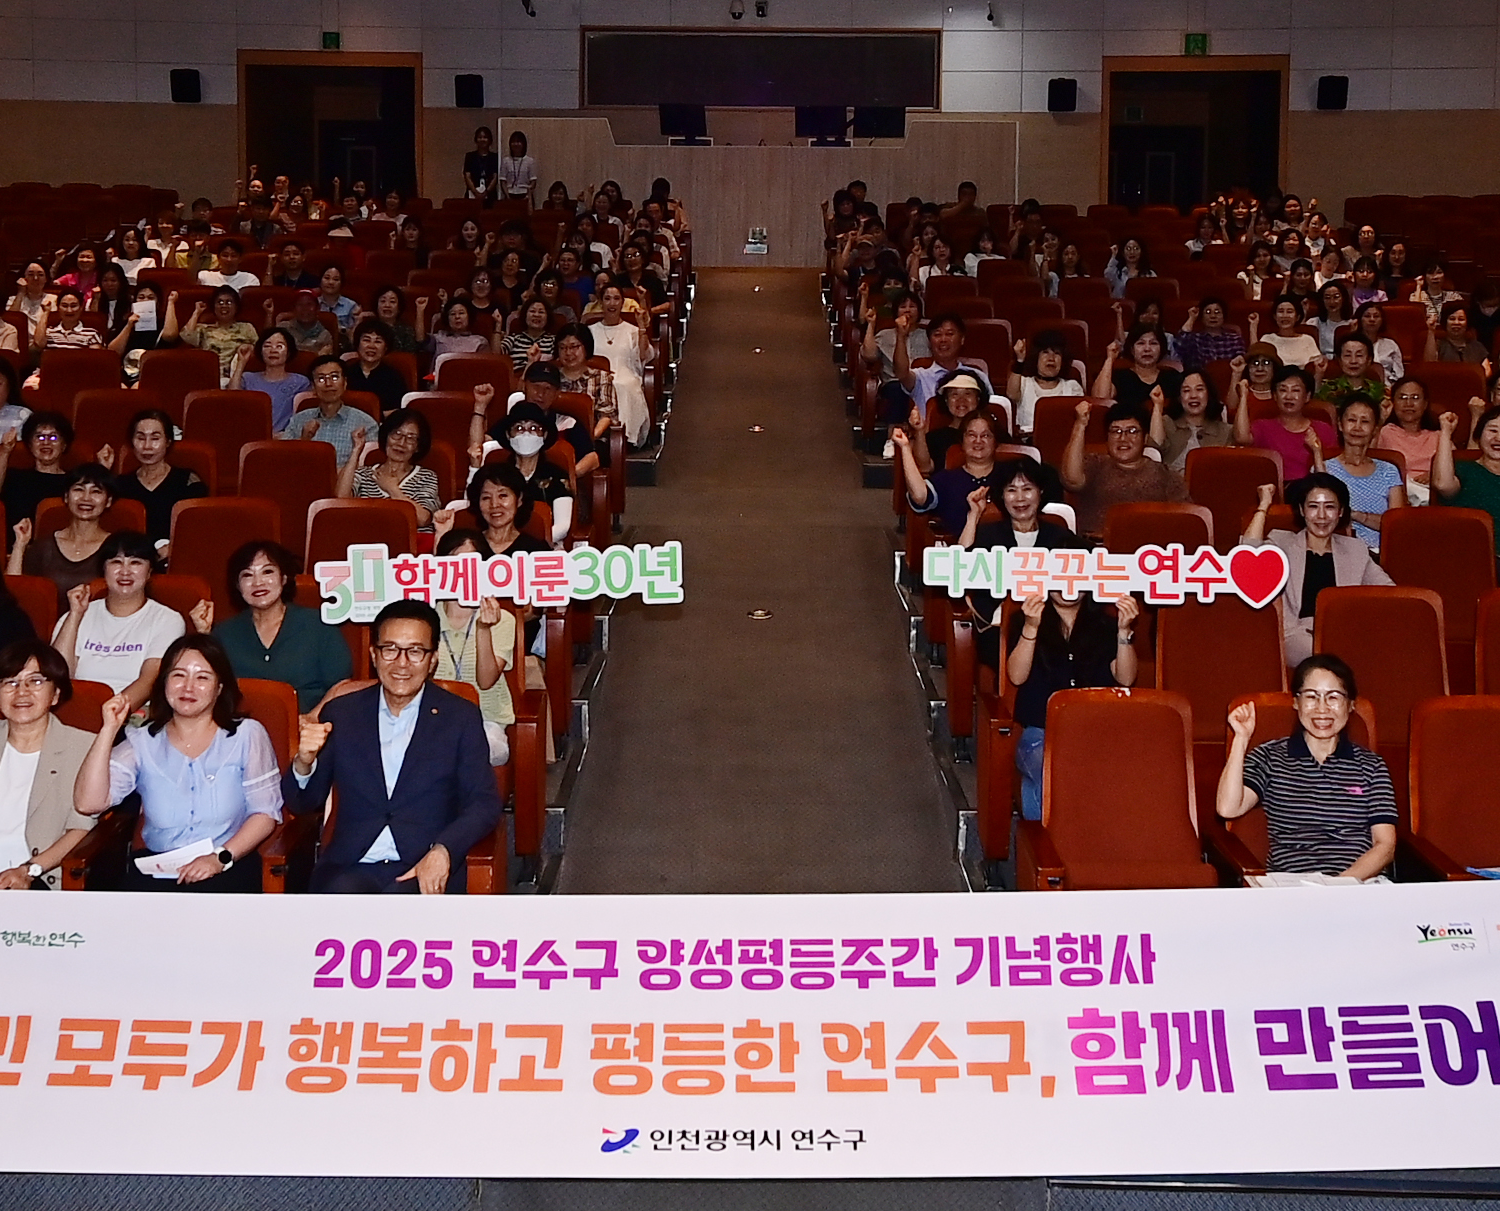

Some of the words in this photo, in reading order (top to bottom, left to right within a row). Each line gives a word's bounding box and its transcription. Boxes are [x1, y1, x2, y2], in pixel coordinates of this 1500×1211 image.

[392, 559, 478, 601] 함께
[927, 550, 1003, 593] 다시
[1011, 551, 1130, 598] 꿈꾸는
[1138, 548, 1228, 600] 연수
[313, 938, 453, 990] 2025
[471, 938, 619, 990] 연수구
[636, 937, 939, 991] 양성평등주간
[954, 932, 1156, 988] 기념행사
[46, 1018, 265, 1091] 모두가
[285, 1017, 564, 1094] 행복하고
[590, 1018, 800, 1096] 평등한
[821, 1020, 1056, 1098] 연수구,
[1067, 1007, 1235, 1096] 함께
[649, 1129, 782, 1152] 인천광역시
[790, 1129, 867, 1152] 연수구
